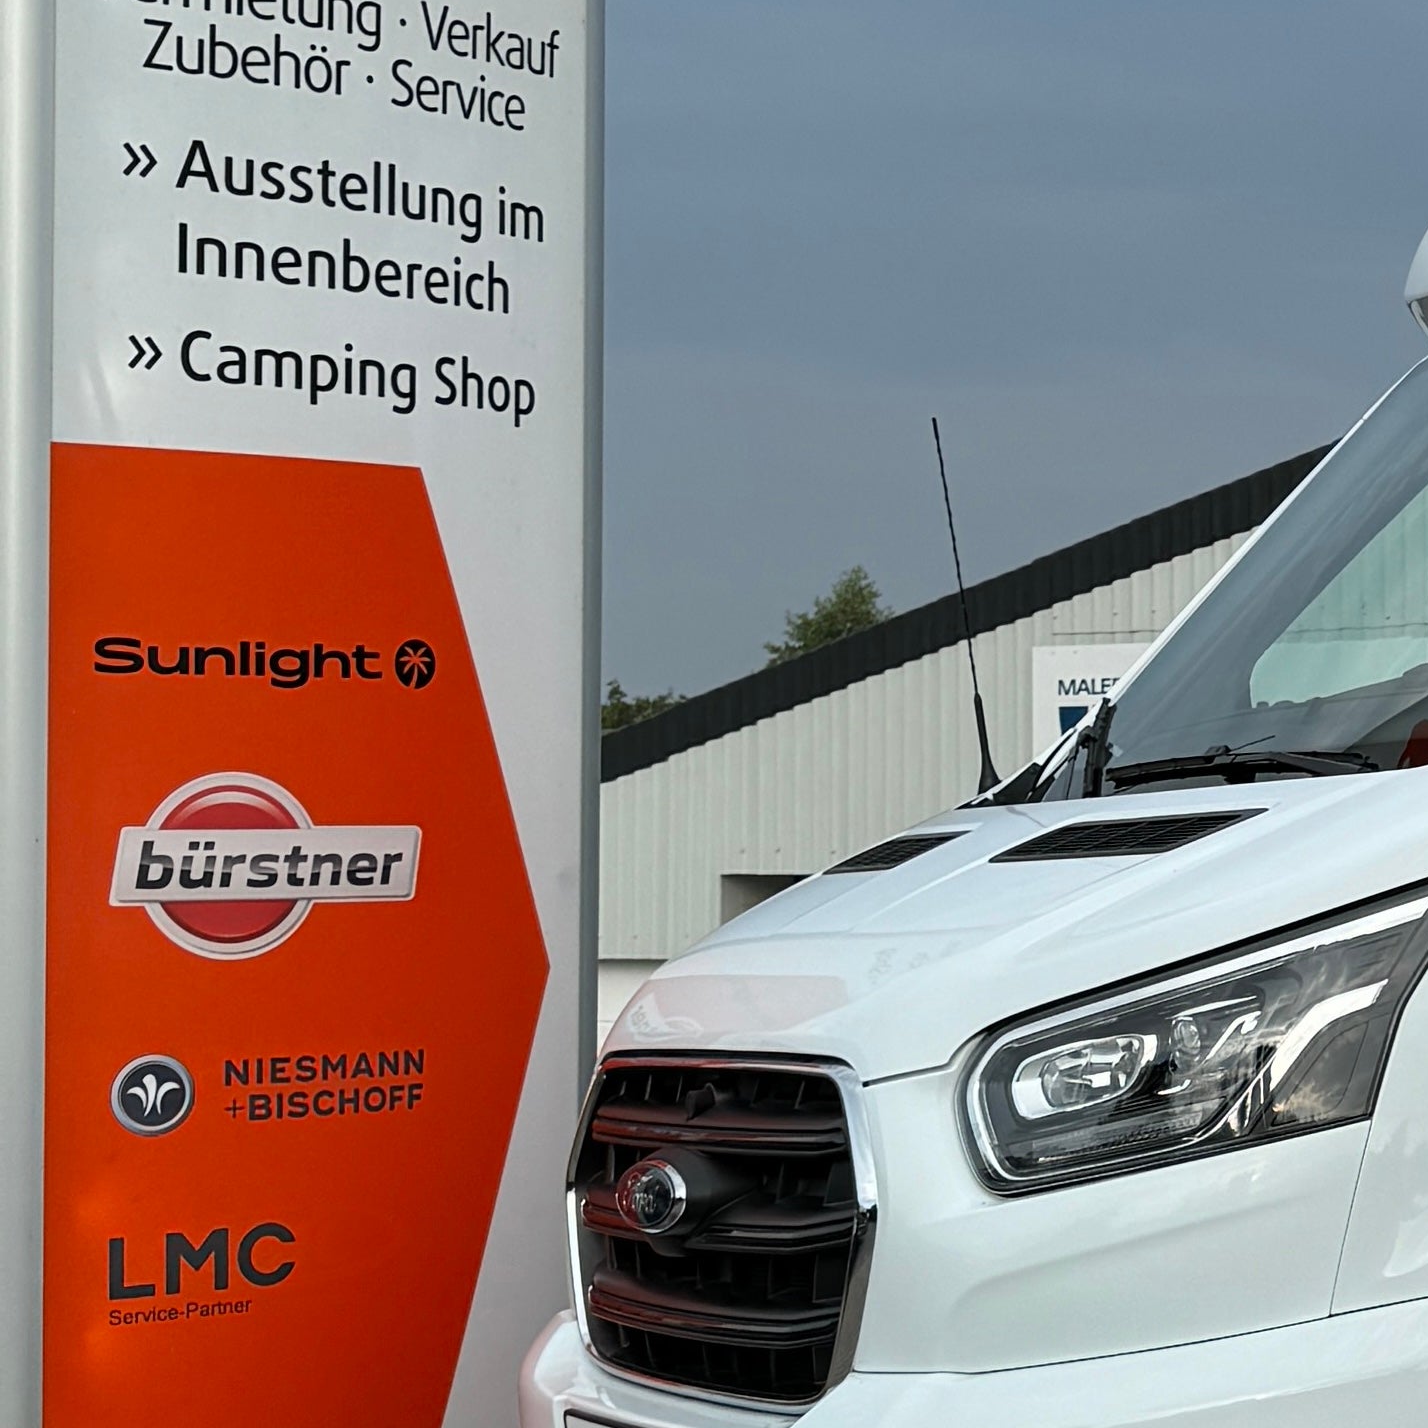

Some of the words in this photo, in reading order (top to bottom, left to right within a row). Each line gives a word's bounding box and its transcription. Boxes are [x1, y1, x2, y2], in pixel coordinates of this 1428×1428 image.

[142, 18, 352, 95] Zubehör
[390, 59, 526, 131] Service
[420, 1, 560, 79] Verkauf
[175, 139, 483, 244] Ausstellung
[498, 186, 545, 243] im
[177, 222, 511, 314] Innenbereich
[180, 330, 417, 415] Camping
[434, 356, 537, 427] Shop
[93, 637, 383, 689] Sunlight
[135, 840, 403, 889] bürstner
[223, 1048, 426, 1087] NIESMANN
[108, 1222, 296, 1301] LMC
[108, 1298, 252, 1327] Service-Partner
